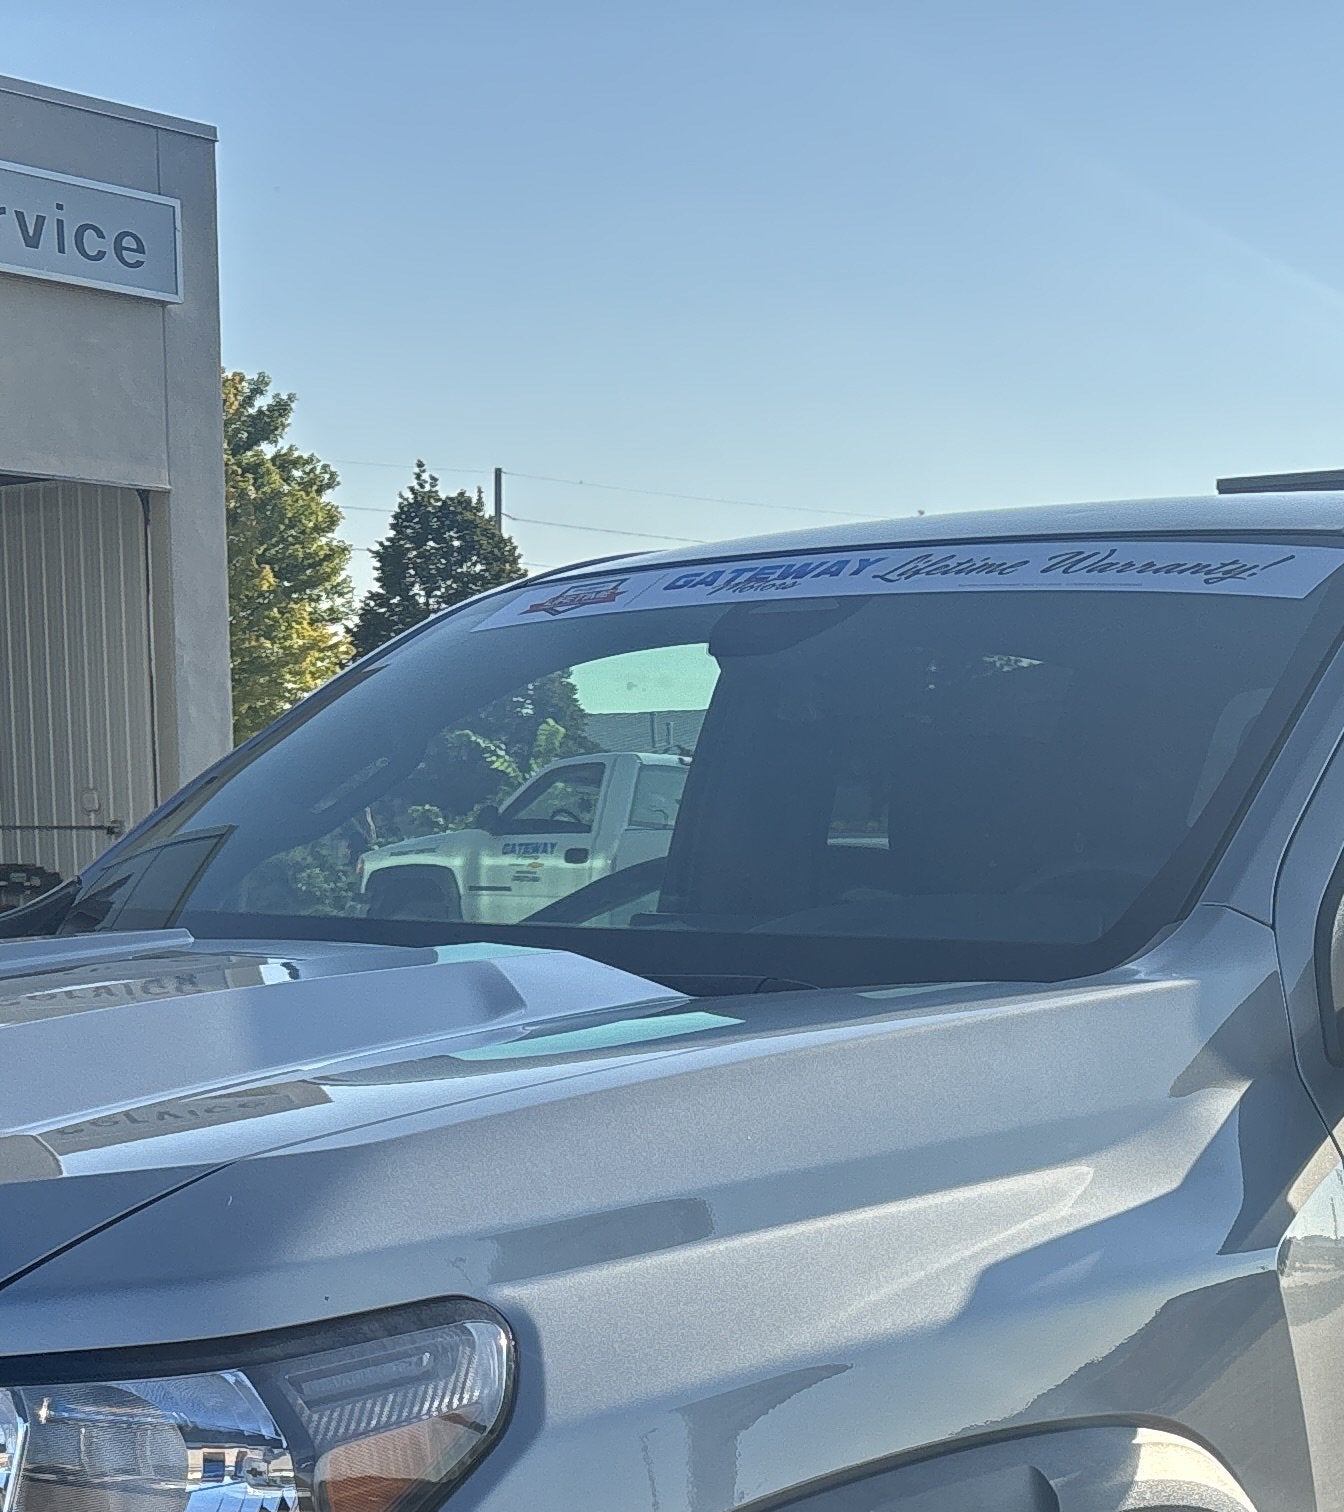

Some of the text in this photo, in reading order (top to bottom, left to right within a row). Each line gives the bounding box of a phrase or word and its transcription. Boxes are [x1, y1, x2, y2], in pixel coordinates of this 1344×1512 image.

[662, 548, 1296, 591] GATEWAY Lifetime Warranty!
[706, 577, 803, 596] Motors
[501, 841, 559, 856] GATEWAY
